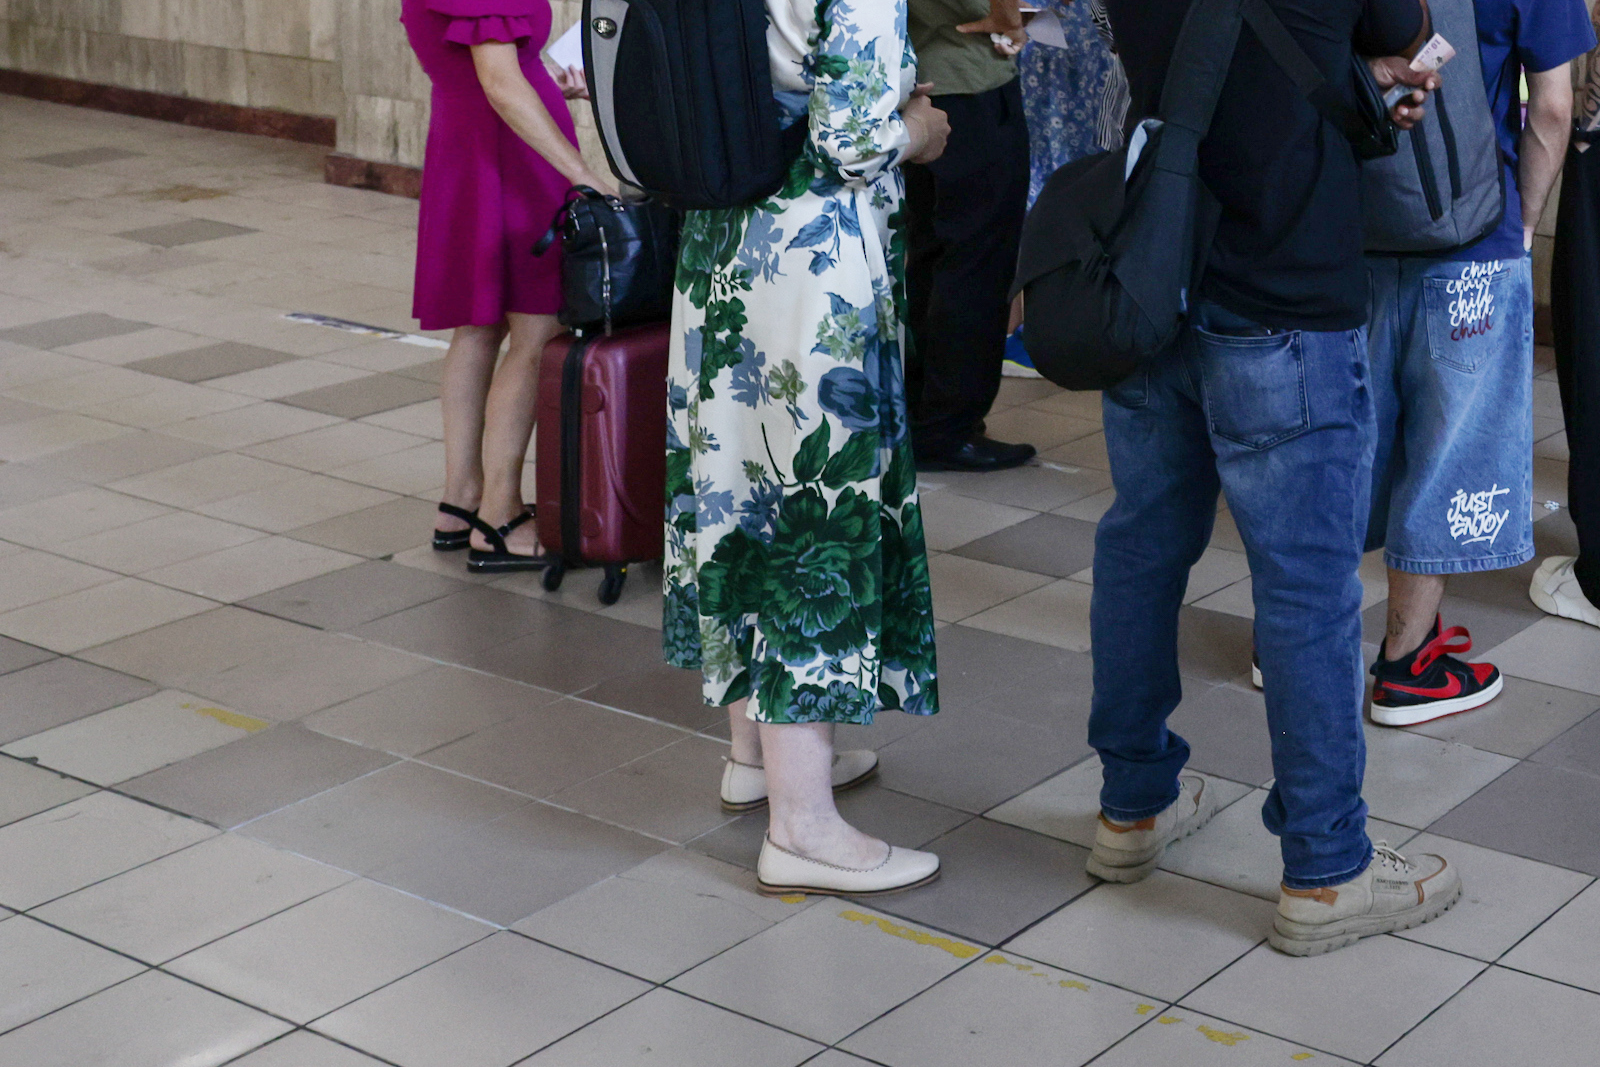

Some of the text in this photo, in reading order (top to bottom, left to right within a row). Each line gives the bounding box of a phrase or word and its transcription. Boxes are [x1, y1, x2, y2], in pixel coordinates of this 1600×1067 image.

[1431, 38, 1441, 50] 10
[1461, 259, 1503, 280] chill
[1451, 314, 1494, 341] chill
[1447, 483, 1510, 523] JUST
[1450, 509, 1510, 547] ENJOY
